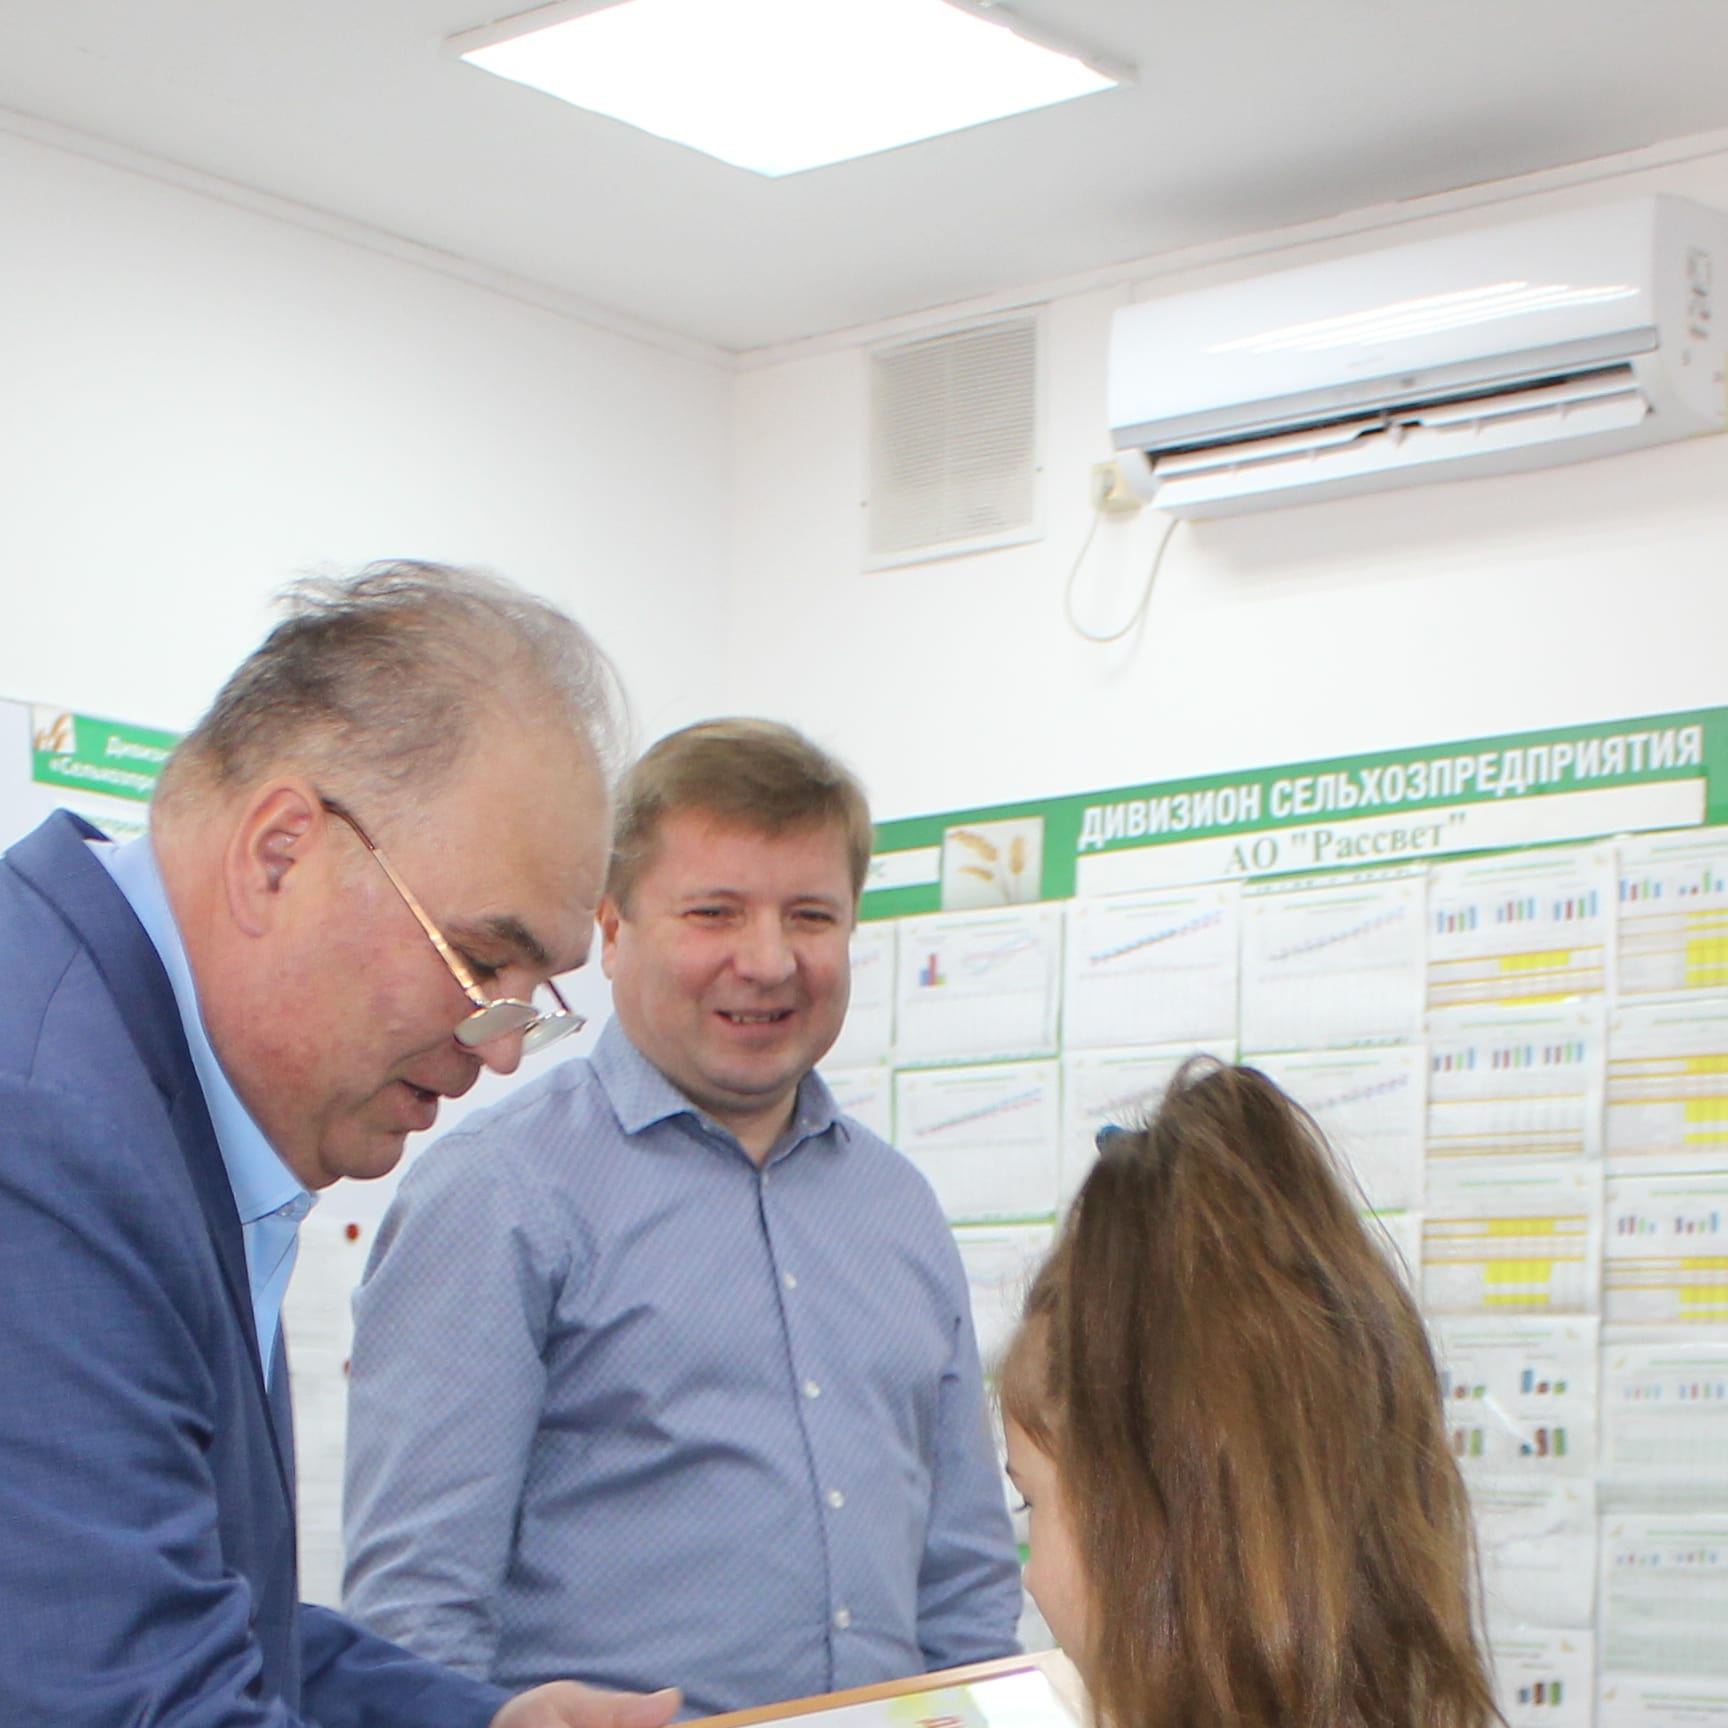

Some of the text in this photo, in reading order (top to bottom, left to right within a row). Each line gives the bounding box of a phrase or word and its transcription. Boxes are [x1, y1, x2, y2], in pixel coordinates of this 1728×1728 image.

[1077, 724, 1704, 851] ДИВИЗИОН СЕЛЬХОЗПРЕДПРИЯТИЯ
[1224, 811, 1467, 875] АО "Рассвет"
